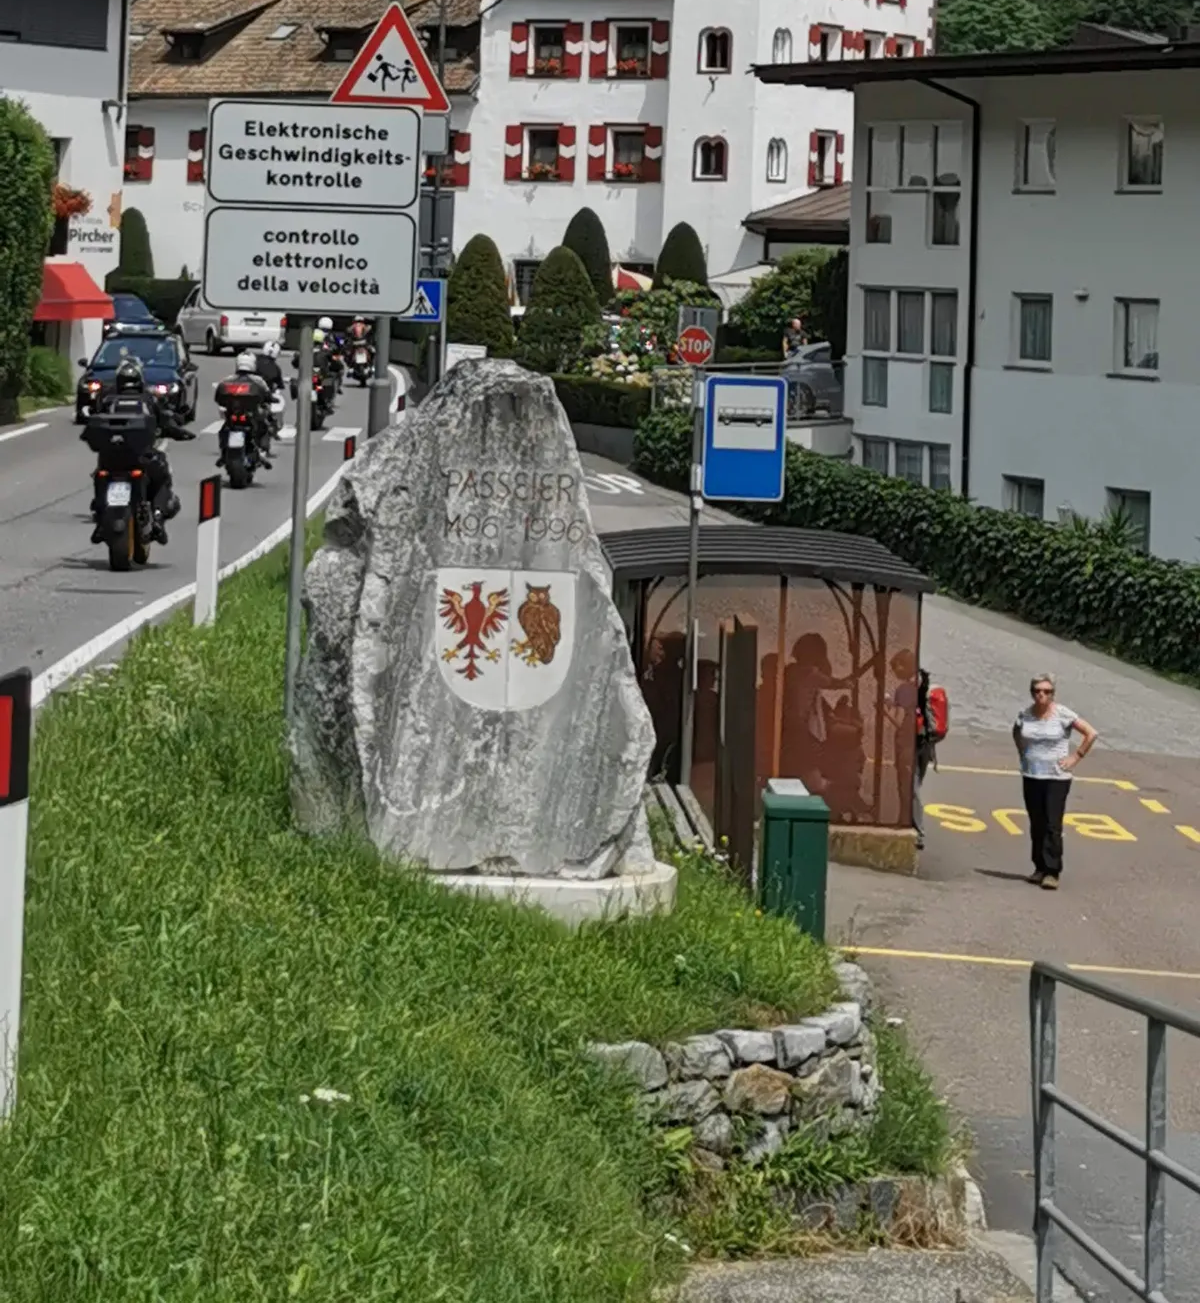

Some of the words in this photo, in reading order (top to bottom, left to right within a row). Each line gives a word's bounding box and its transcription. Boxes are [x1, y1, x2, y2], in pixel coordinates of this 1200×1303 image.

[244, 120, 389, 141] Elektronische
[218, 144, 412, 167] Geschwindigkeits-
[266, 170, 363, 188] kontrolle
[69, 228, 115, 244] Pircher
[263, 229, 360, 246] controllo
[252, 251, 368, 270] elettronico
[237, 275, 290, 293] della
[297, 277, 381, 295] velocità
[679, 336, 712, 354] STOP
[446, 469, 575, 503] PASSEIER
[524, 515, 586, 544] 1996
